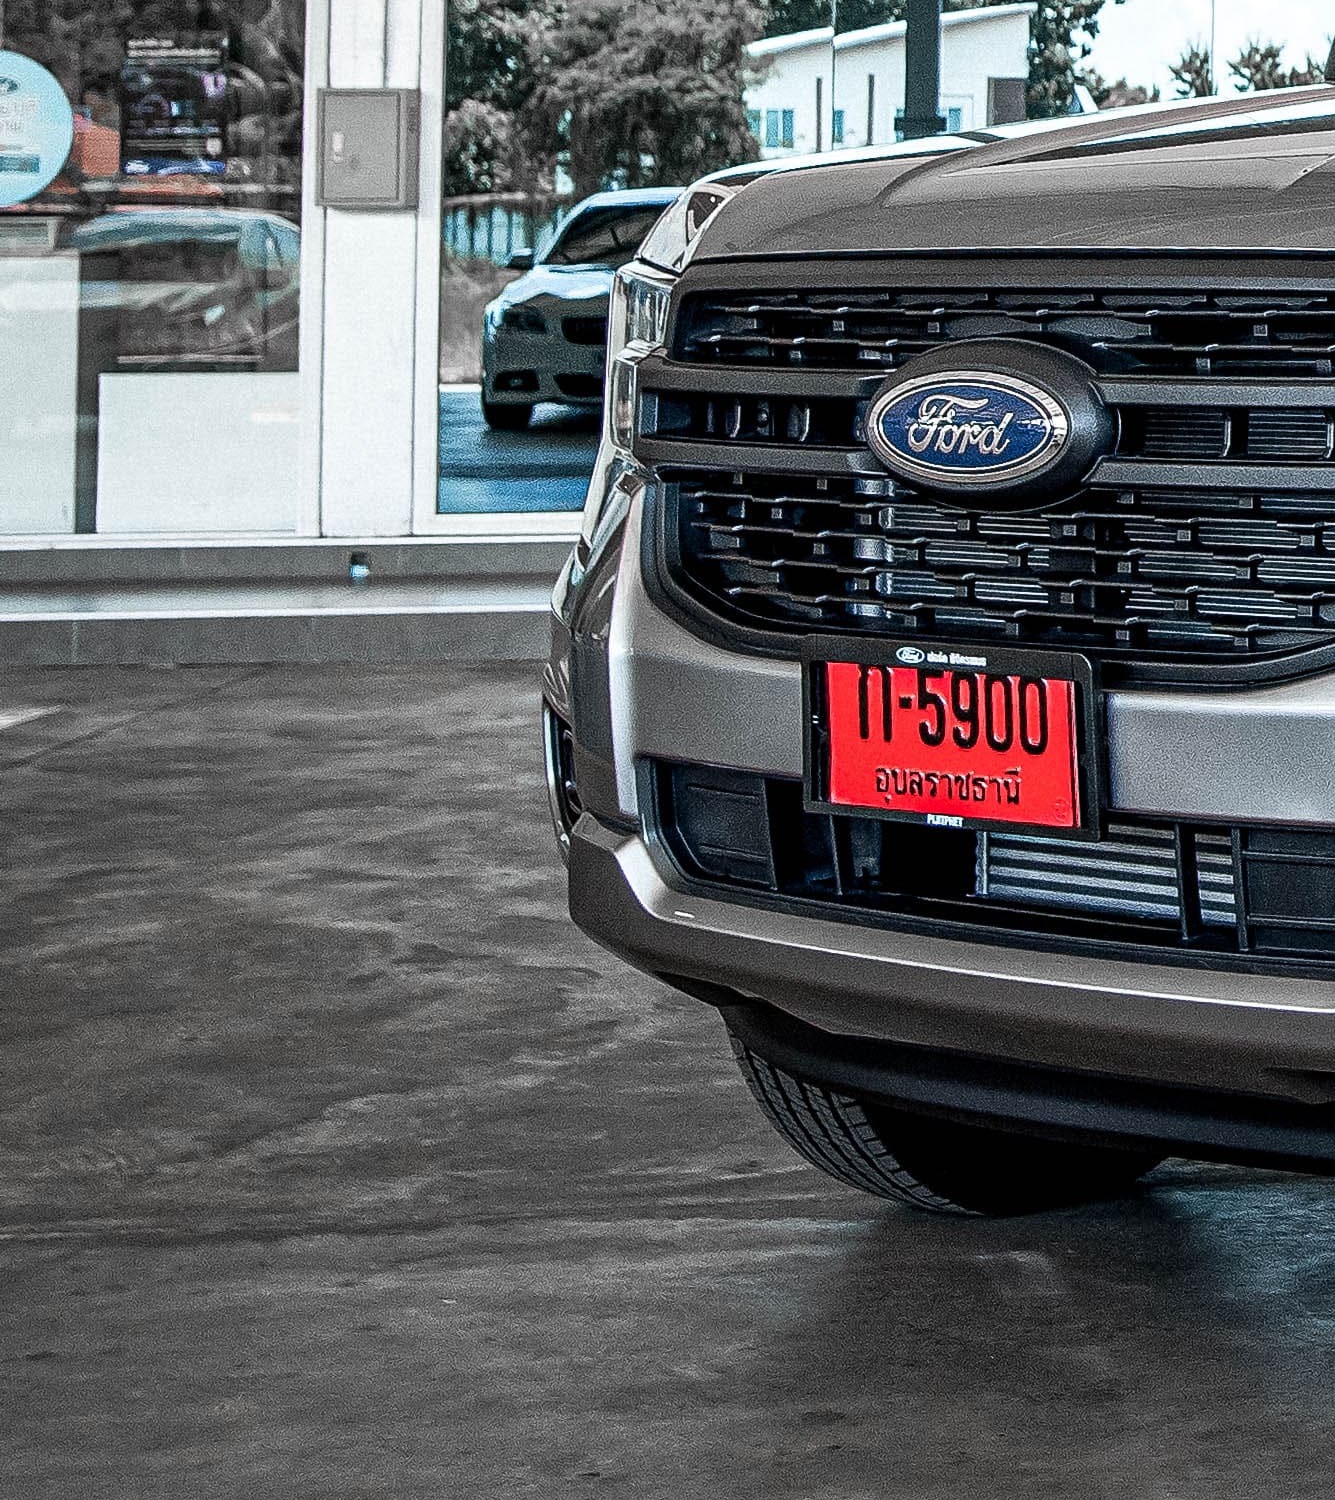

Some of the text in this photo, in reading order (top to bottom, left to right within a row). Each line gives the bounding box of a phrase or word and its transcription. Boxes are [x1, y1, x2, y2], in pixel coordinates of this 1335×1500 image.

[907, 394, 1015, 456] Ford
[875, 766, 1023, 805] อุบลราชธานี
